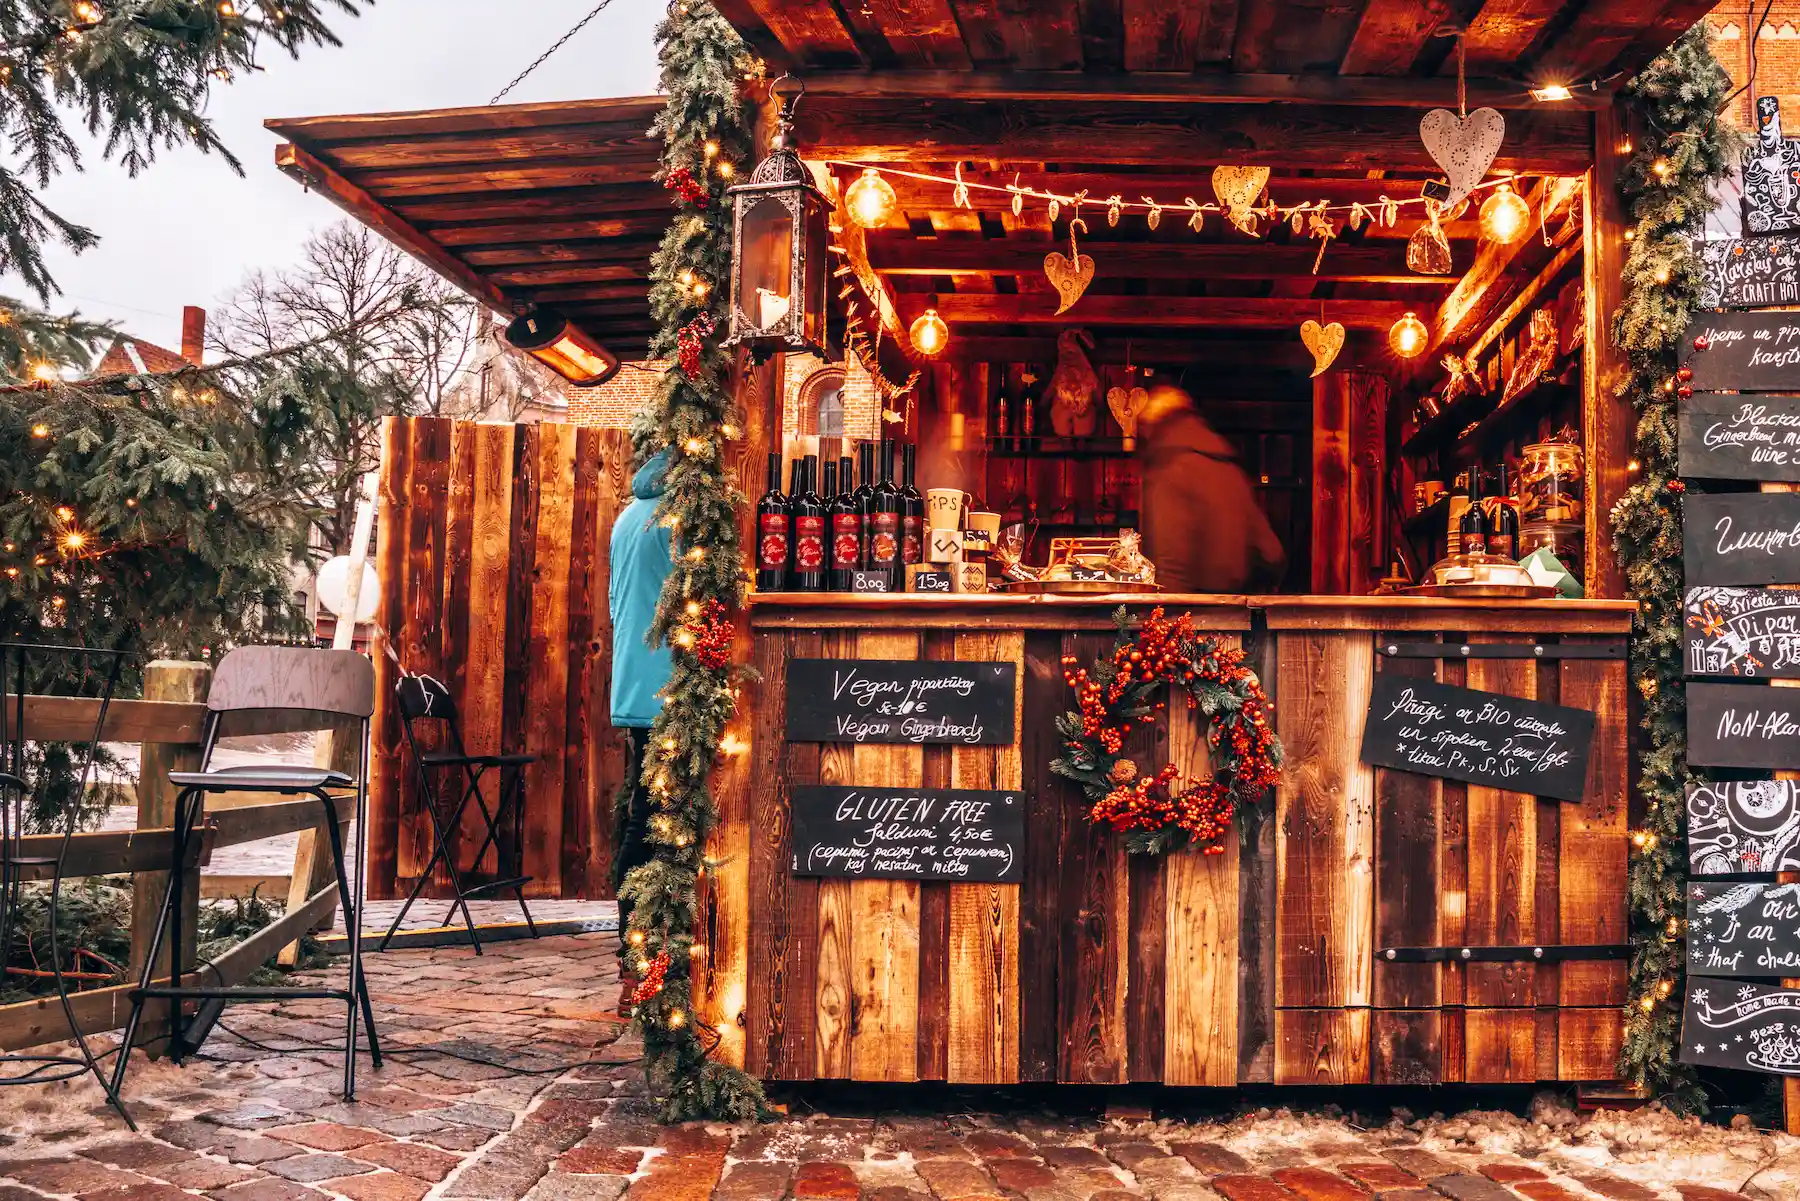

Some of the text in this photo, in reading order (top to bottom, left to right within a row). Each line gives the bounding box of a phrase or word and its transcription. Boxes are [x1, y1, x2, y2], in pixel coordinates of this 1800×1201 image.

[1743, 281, 1799, 302] CRAFT HOT
[1753, 329, 1772, 341] un
[834, 668, 903, 706] Vegan
[1456, 708, 1474, 729] ar
[1476, 702, 1510, 725] BIO
[837, 714, 889, 741] Vegan
[1398, 725, 1427, 742] un
[836, 792, 992, 825] GLUTEN FREE
[921, 845, 937, 856] ar
[844, 858, 866, 874] kas
[1747, 925, 1776, 941] an
[1706, 946, 1744, 971] that
